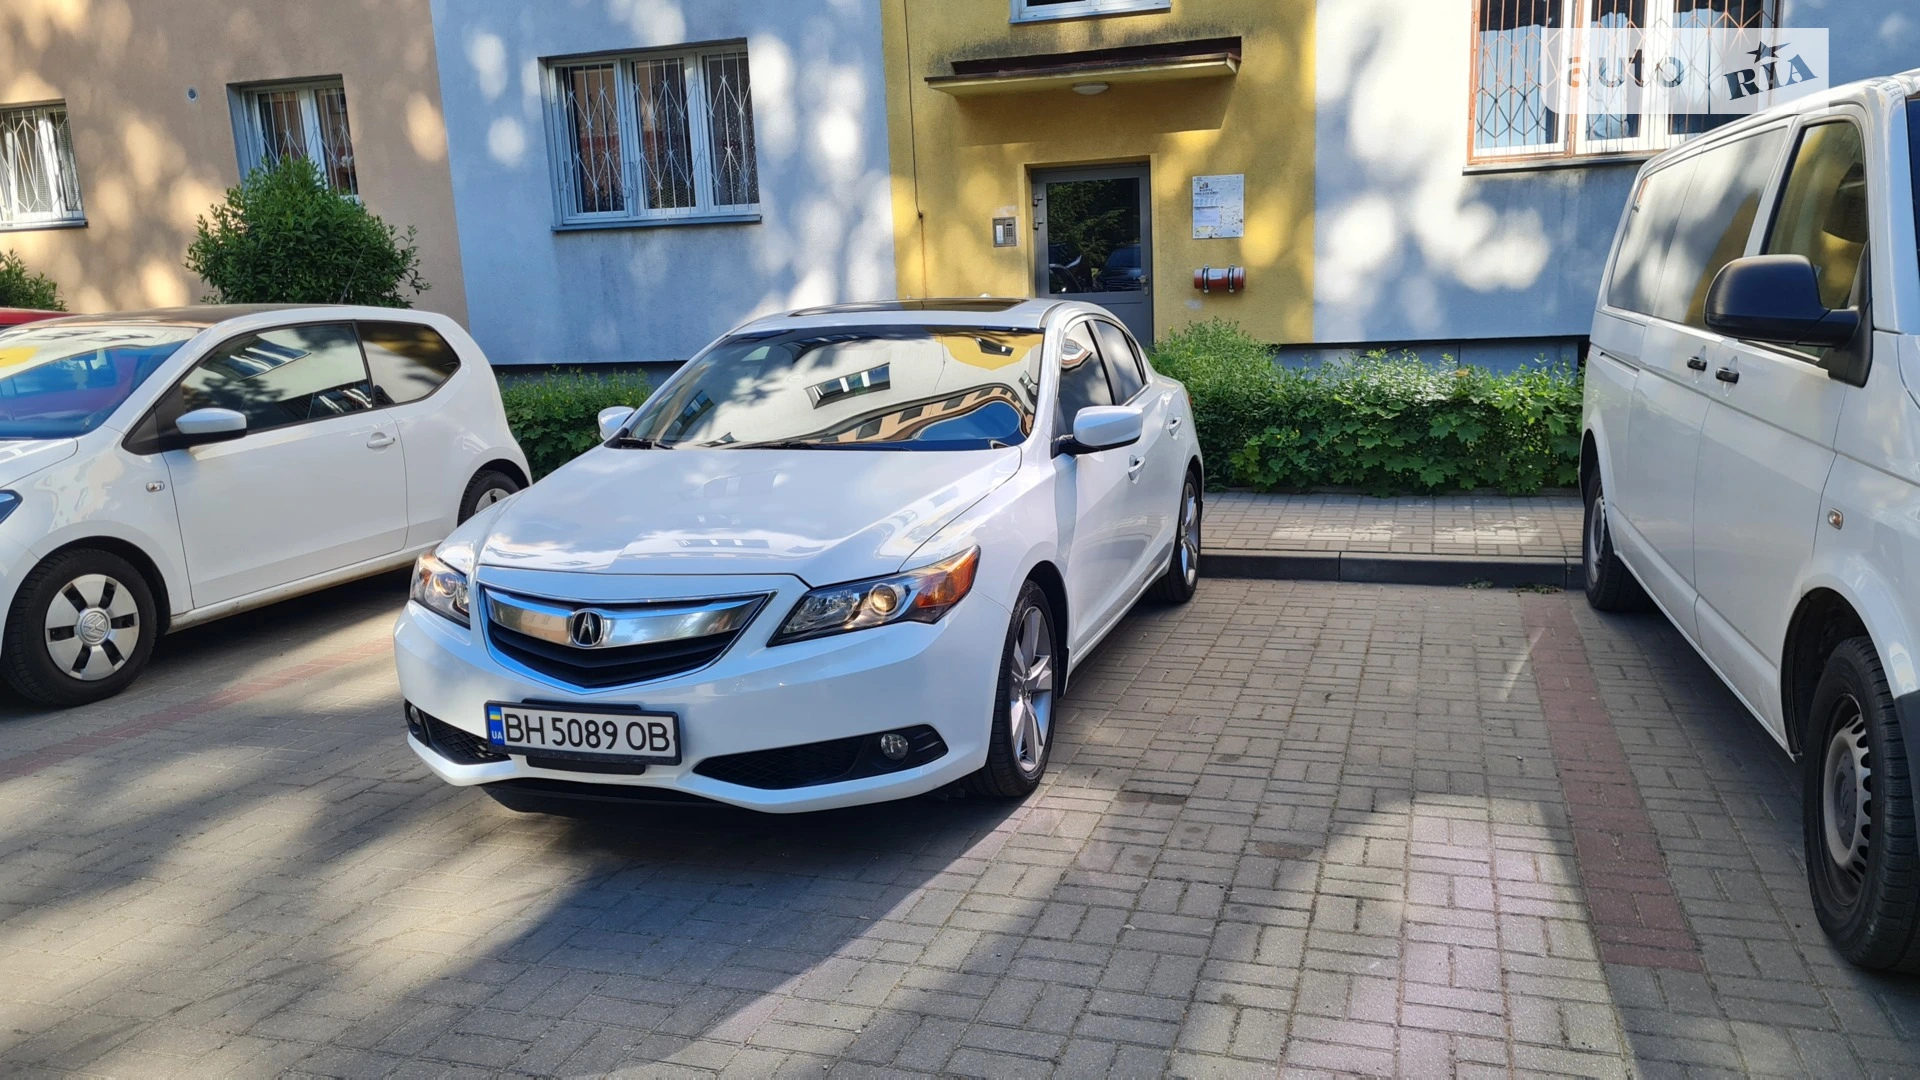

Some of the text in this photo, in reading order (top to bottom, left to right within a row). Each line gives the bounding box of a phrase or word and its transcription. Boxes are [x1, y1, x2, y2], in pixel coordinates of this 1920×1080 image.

[491, 731, 503, 740] UA
[504, 714, 670, 751] BH 5089 OB
